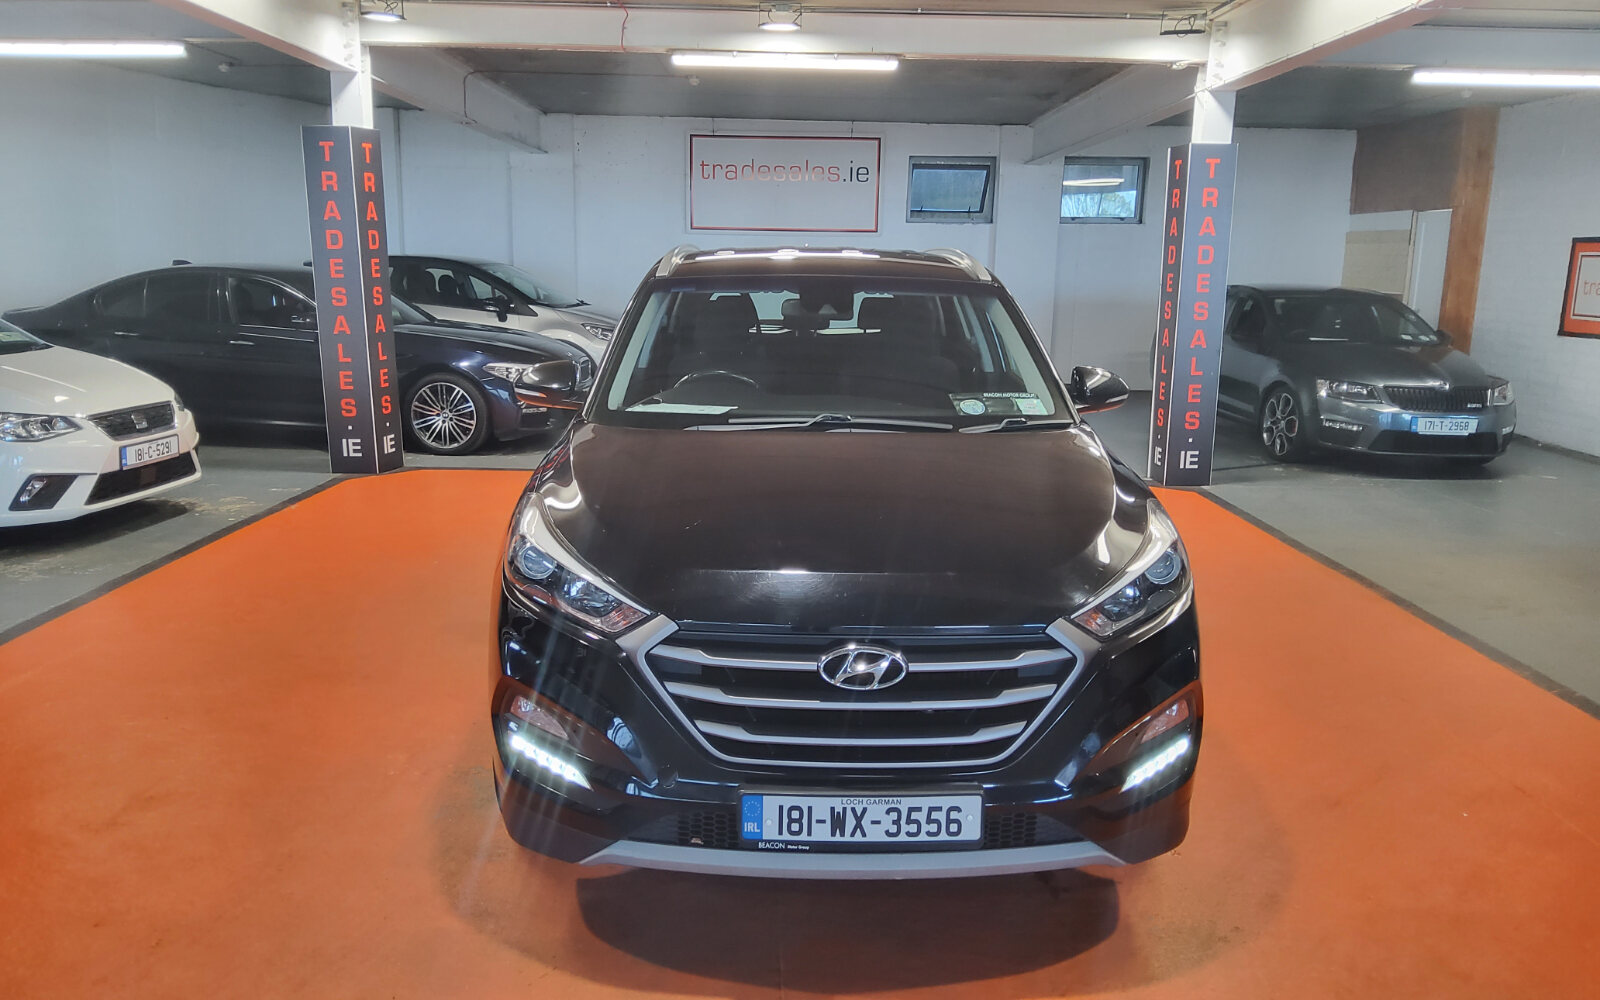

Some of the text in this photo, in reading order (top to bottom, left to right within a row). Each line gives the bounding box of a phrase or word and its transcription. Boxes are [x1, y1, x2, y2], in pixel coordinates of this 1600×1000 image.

[699, 158, 870, 183] tradesales.ie
[134, 440, 172, 463] 181-C-5291
[840, 798, 902, 806] LOCH GARMAN
[743, 822, 761, 833] IRL
[777, 804, 963, 838] 181-WX-3556
[758, 841, 786, 849] BEACON
